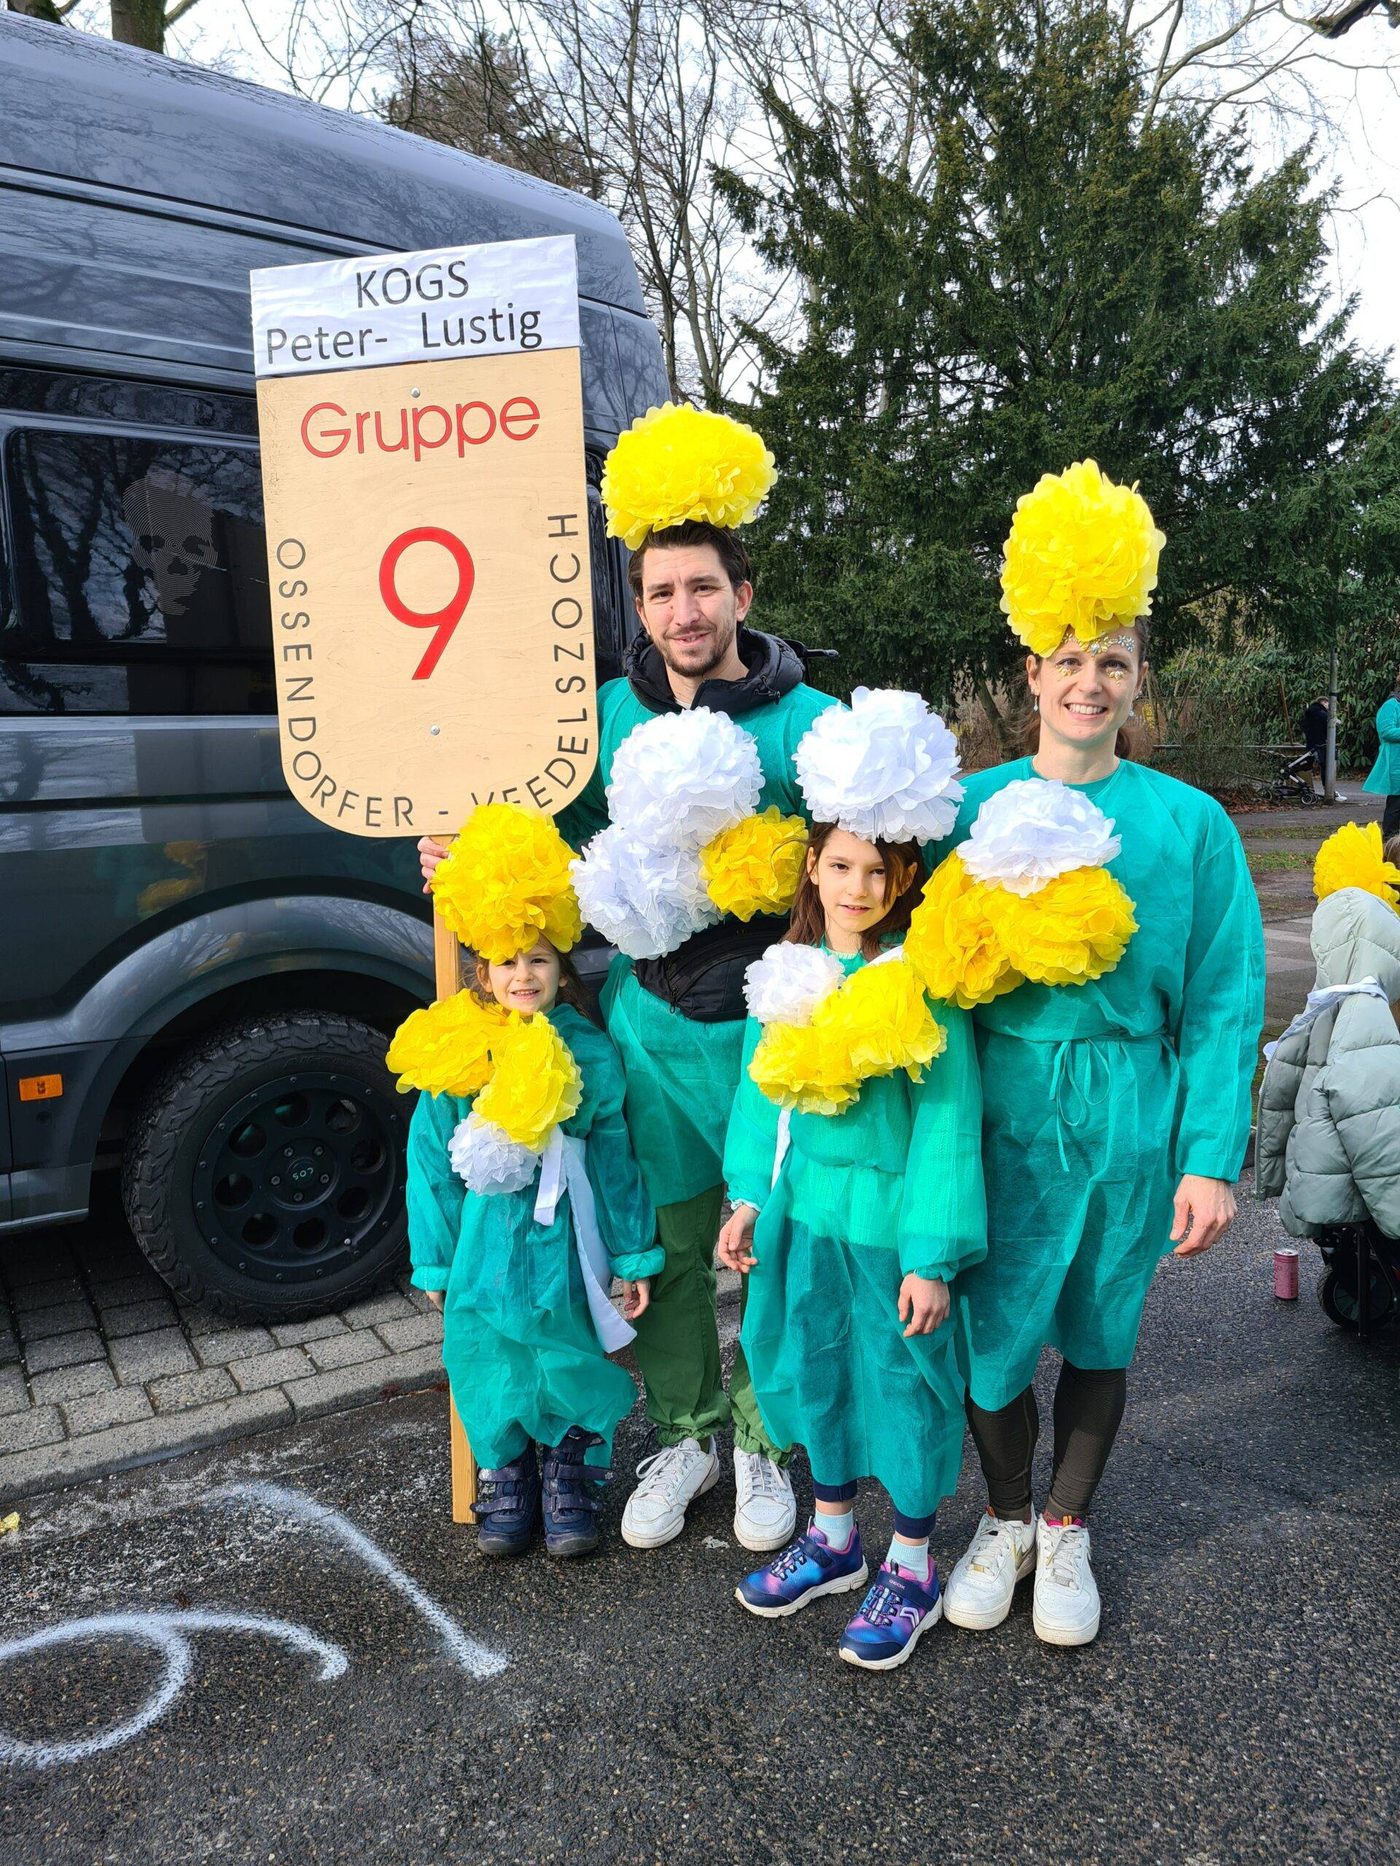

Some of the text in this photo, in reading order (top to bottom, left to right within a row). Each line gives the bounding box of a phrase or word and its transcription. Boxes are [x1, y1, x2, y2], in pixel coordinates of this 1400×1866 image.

[355, 260, 469, 309] KOGS
[266, 302, 543, 365] Peter- Lustig
[300, 396, 541, 462] Gruppe
[379, 526, 476, 680] 9
[276, 537, 414, 827] OSSENDORFER
